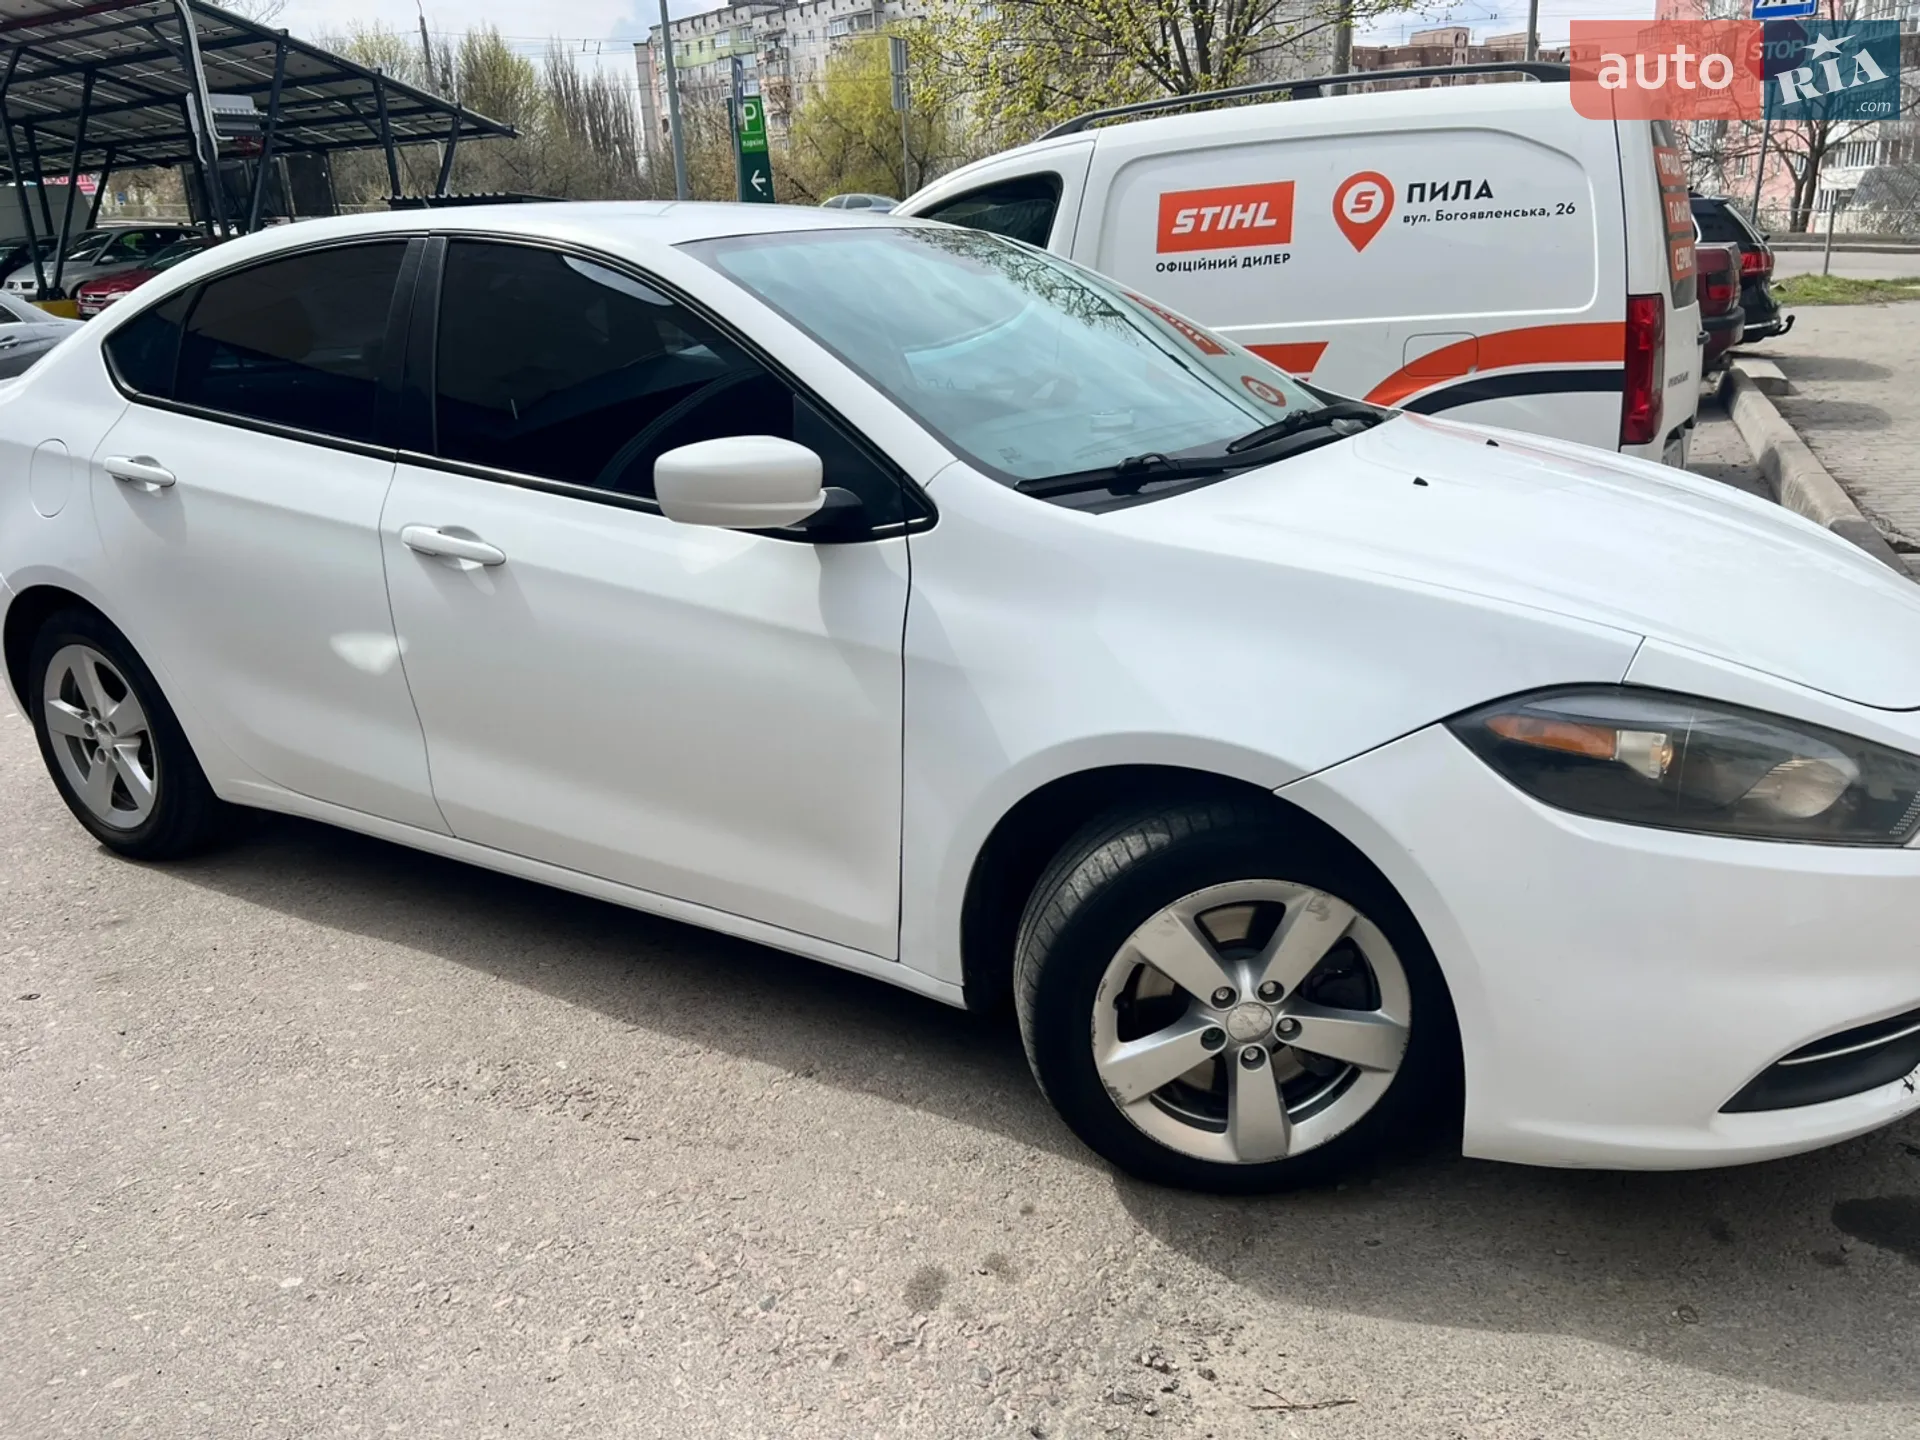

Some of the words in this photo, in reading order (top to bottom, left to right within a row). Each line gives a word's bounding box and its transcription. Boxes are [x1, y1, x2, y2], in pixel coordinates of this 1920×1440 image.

[1748, 40, 1805, 60] STOP
[1351, 190, 1377, 213] S
[1407, 179, 1493, 203] ПИЛА
[1171, 202, 1277, 234] STIHL
[1403, 214, 1431, 226] вул.
[1435, 208, 1551, 221] Богоявленська,
[1555, 202, 1576, 216] 26
[1155, 255, 1238, 273] ОФІЦІЙНИЙ
[1241, 253, 1291, 269] ДИЛЕР
